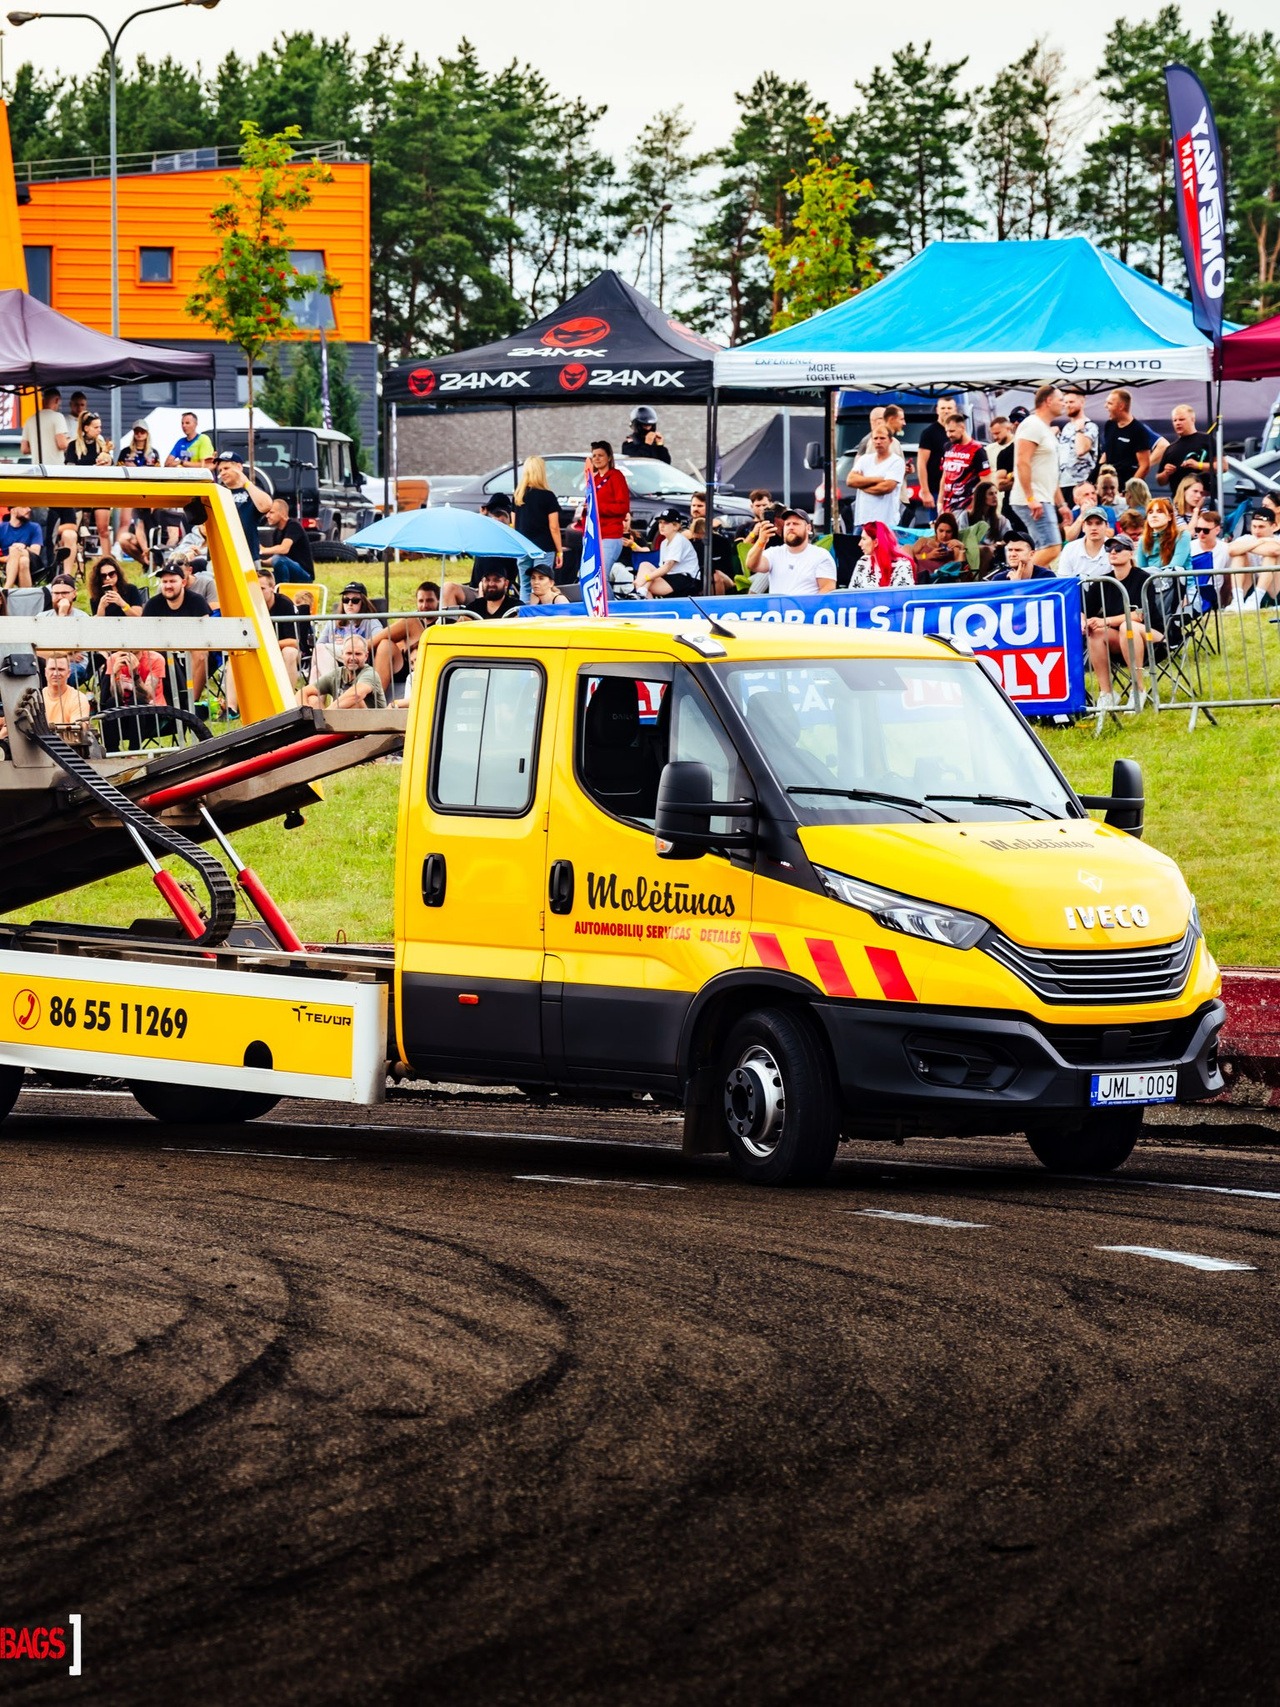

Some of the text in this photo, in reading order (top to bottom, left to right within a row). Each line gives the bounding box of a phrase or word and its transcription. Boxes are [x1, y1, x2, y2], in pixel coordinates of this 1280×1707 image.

[506, 347, 608, 357] 24MX
[808, 364, 836, 372] MORE
[1083, 360, 1162, 370] CFMOTO
[438, 371, 531, 391] 24MX
[587, 369, 685, 388] 24MX
[806, 373, 856, 382] TOGETHER
[587, 872, 735, 917] Molėtūnas
[1064, 904, 1150, 930] IVECO
[574, 921, 644, 941] AUTOMOBILIŲ
[646, 924, 692, 941] SERVISAS
[49, 996, 188, 1039] 86 55 11269
[305, 1012, 352, 1027] TEVOR
[1101, 1074, 1175, 1098] JML 009
